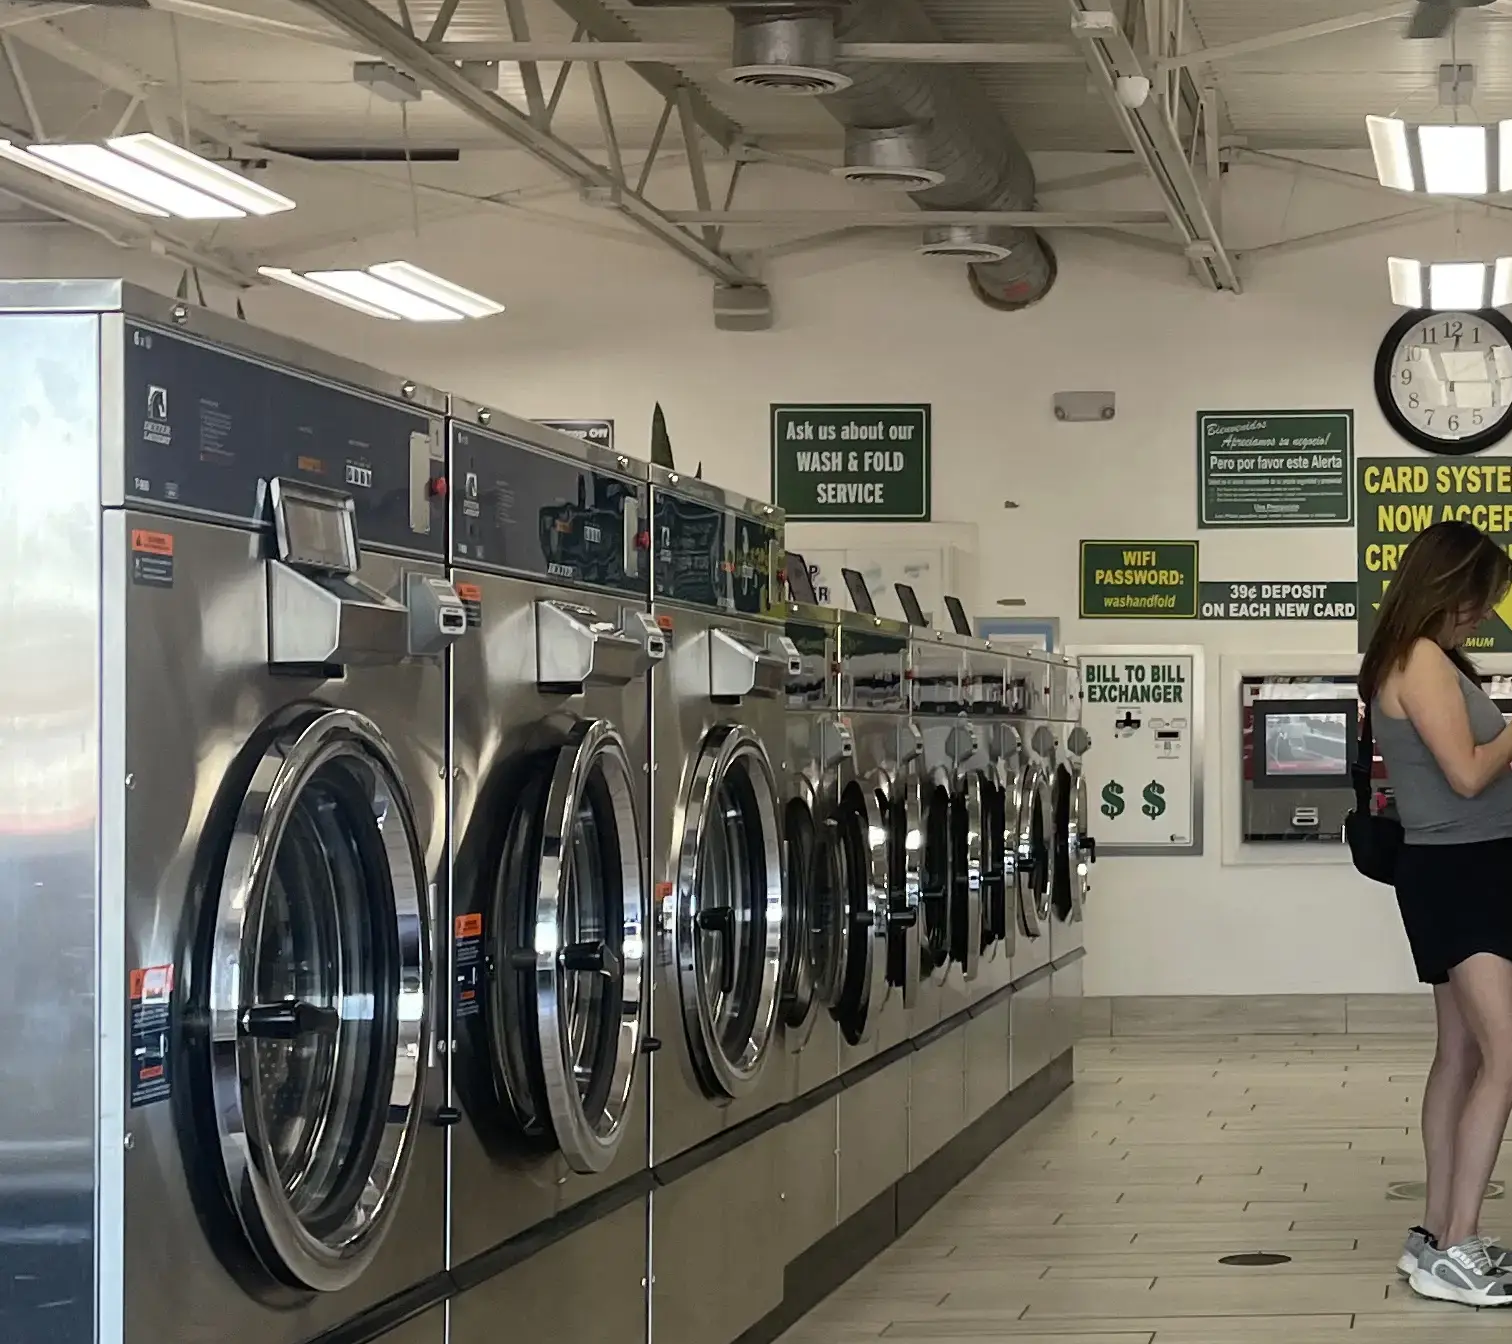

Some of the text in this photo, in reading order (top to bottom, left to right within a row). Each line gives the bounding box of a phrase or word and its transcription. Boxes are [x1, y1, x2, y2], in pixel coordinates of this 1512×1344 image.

[1421, 327, 1438, 345] 11
[1443, 321, 1463, 338] 12
[1472, 327, 1480, 344] 1
[1404, 345, 1421, 362] 10
[1401, 368, 1412, 386] 9
[1408, 392, 1420, 409] 8
[1424, 408, 1435, 425] 7
[1448, 414, 1459, 431] 6
[1472, 409, 1484, 425] 5
[786, 421, 915, 440] Ask us about our
[797, 451, 904, 472] WASH & FOLD
[1210, 454, 1342, 471] Pero por favor este Alerta
[1364, 466, 1429, 494] CARD
[816, 483, 884, 504] SERVICE
[1378, 504, 1433, 533] NOW
[1122, 551, 1156, 566] WIFI
[1095, 570, 1184, 585] PASSWORD:
[1262, 584, 1327, 599] DEPOSIT
[1104, 594, 1176, 608] washandfold
[1202, 603, 1355, 617] ON EACH NEW CARD
[1086, 664, 1185, 683] BILL TO BILL
[1087, 684, 1183, 703] EXCHANGER
